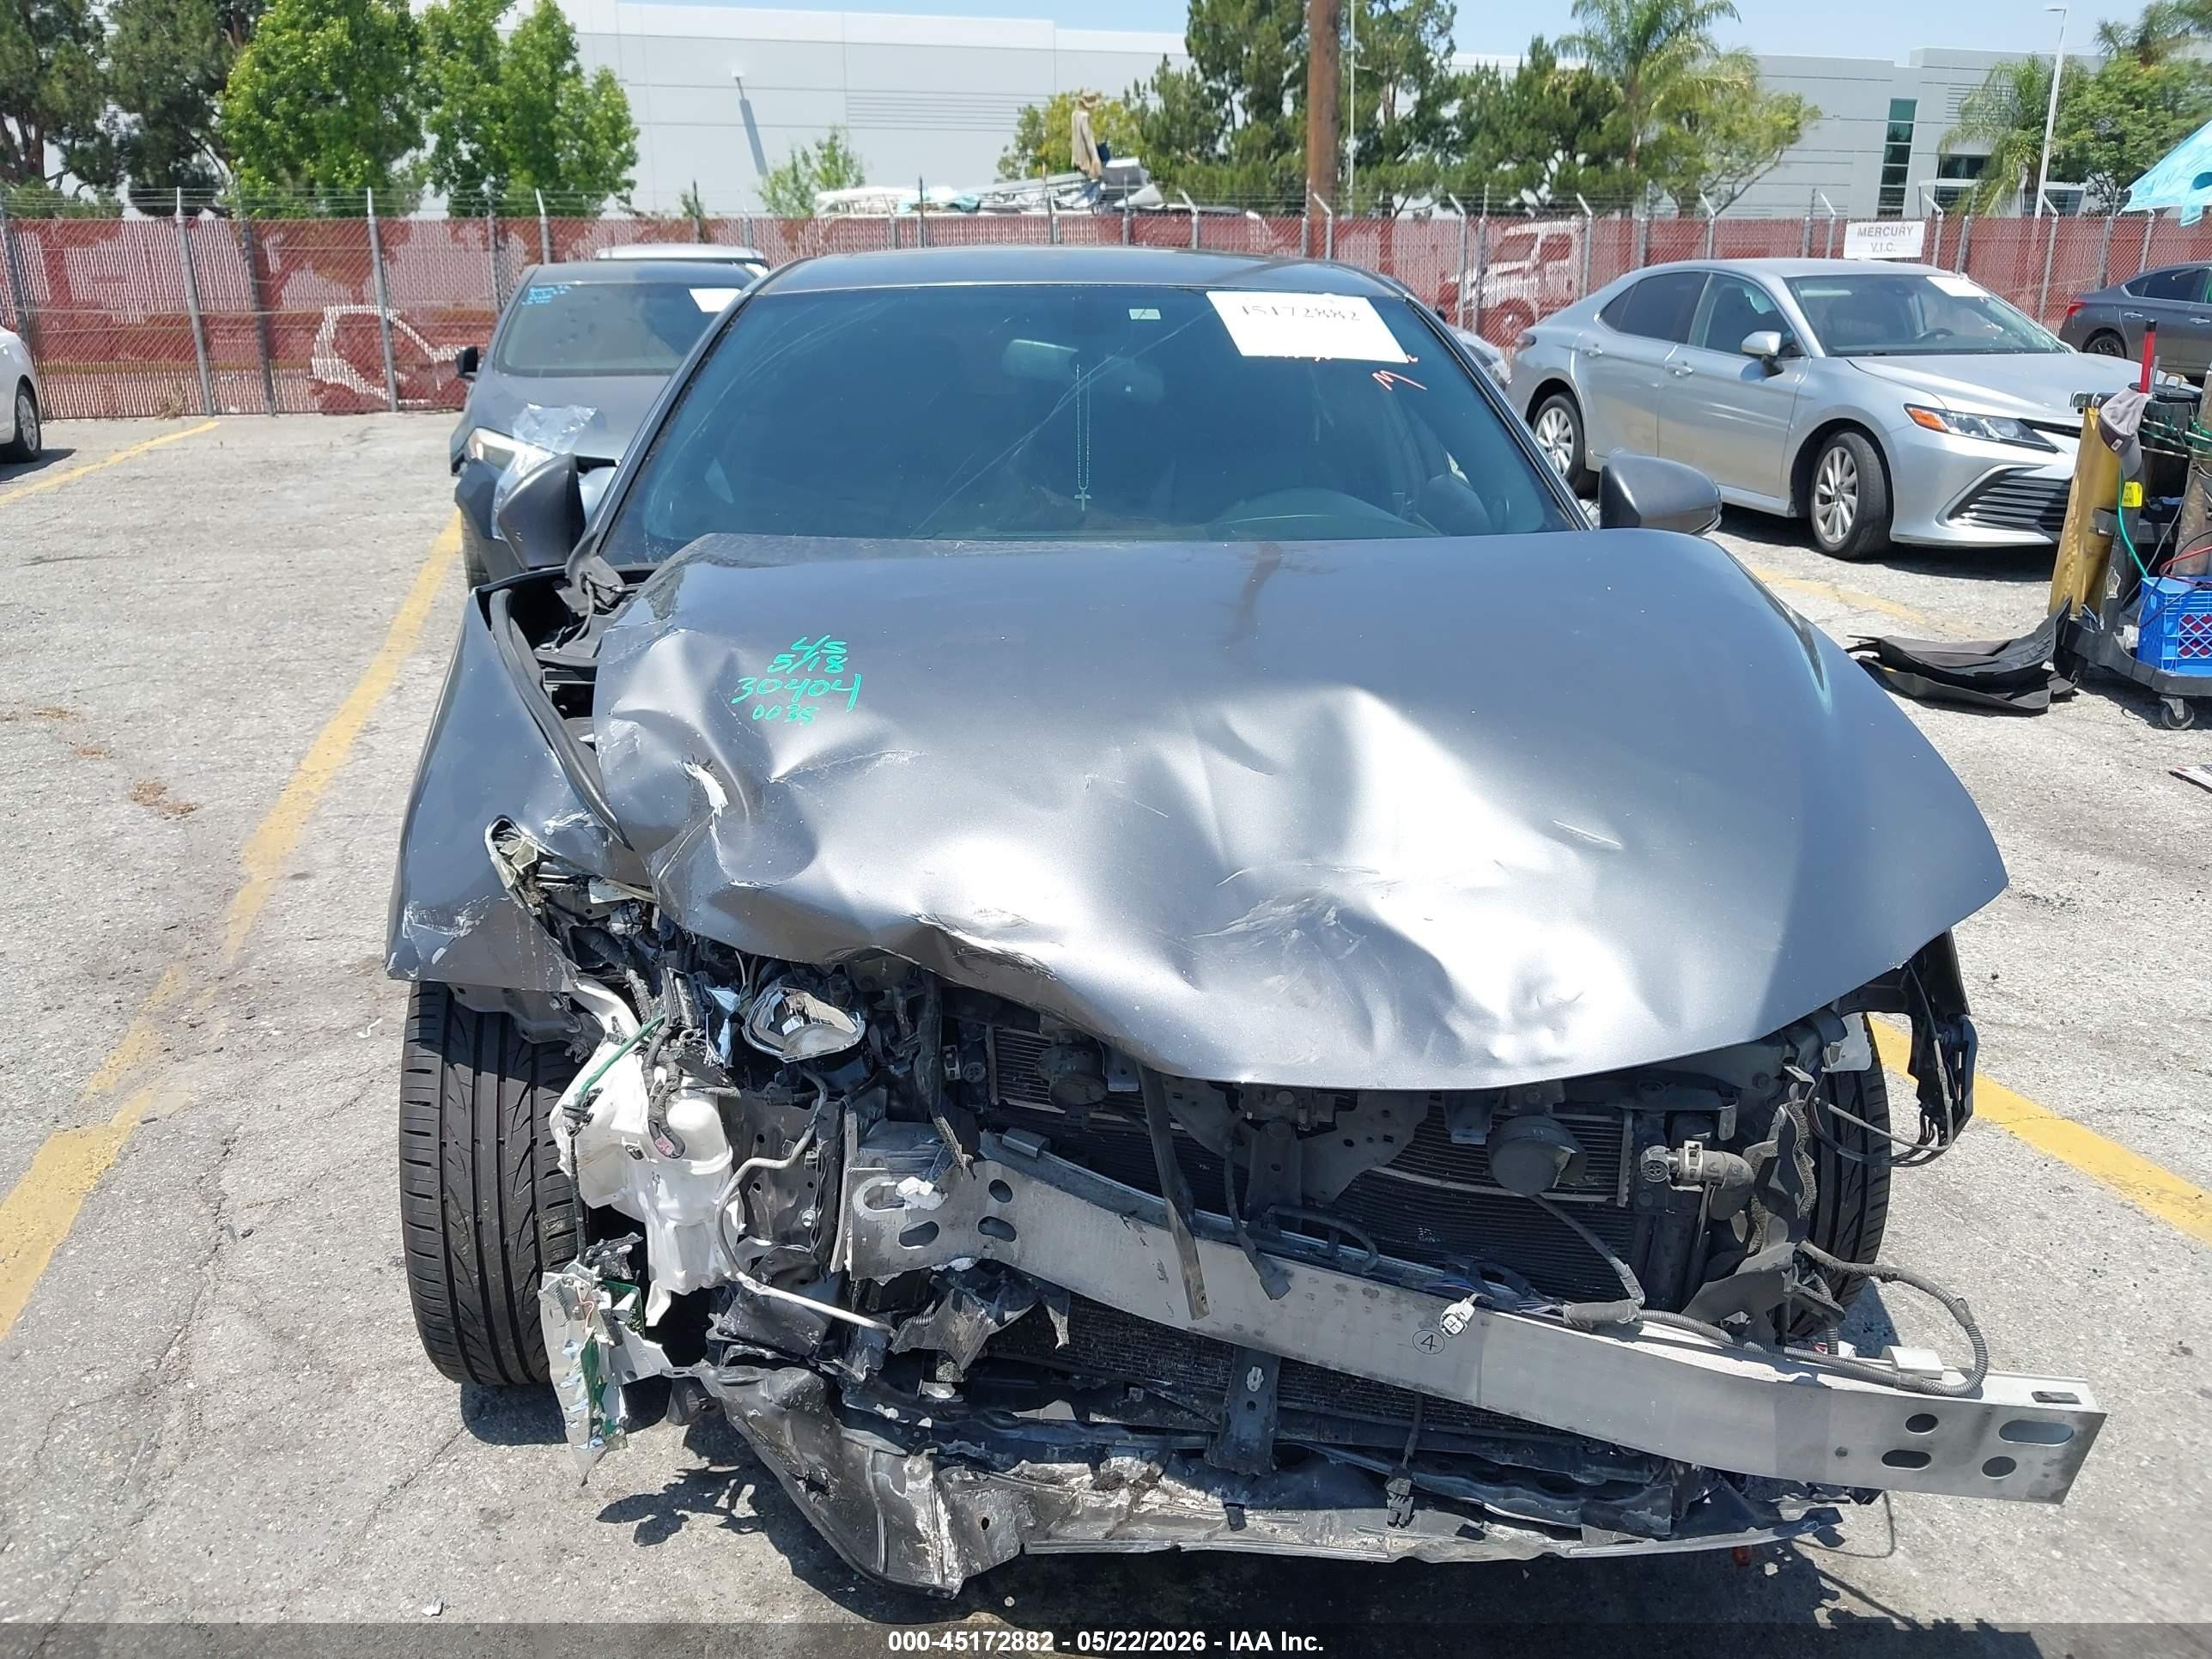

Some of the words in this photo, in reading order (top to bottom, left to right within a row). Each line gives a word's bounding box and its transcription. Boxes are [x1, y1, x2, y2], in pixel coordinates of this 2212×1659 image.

[1856, 226, 1913, 238] MERCURY
[767, 652, 848, 674] 5/18
[732, 673, 861, 713] 30404
[1420, 1334, 1437, 1351] 4
